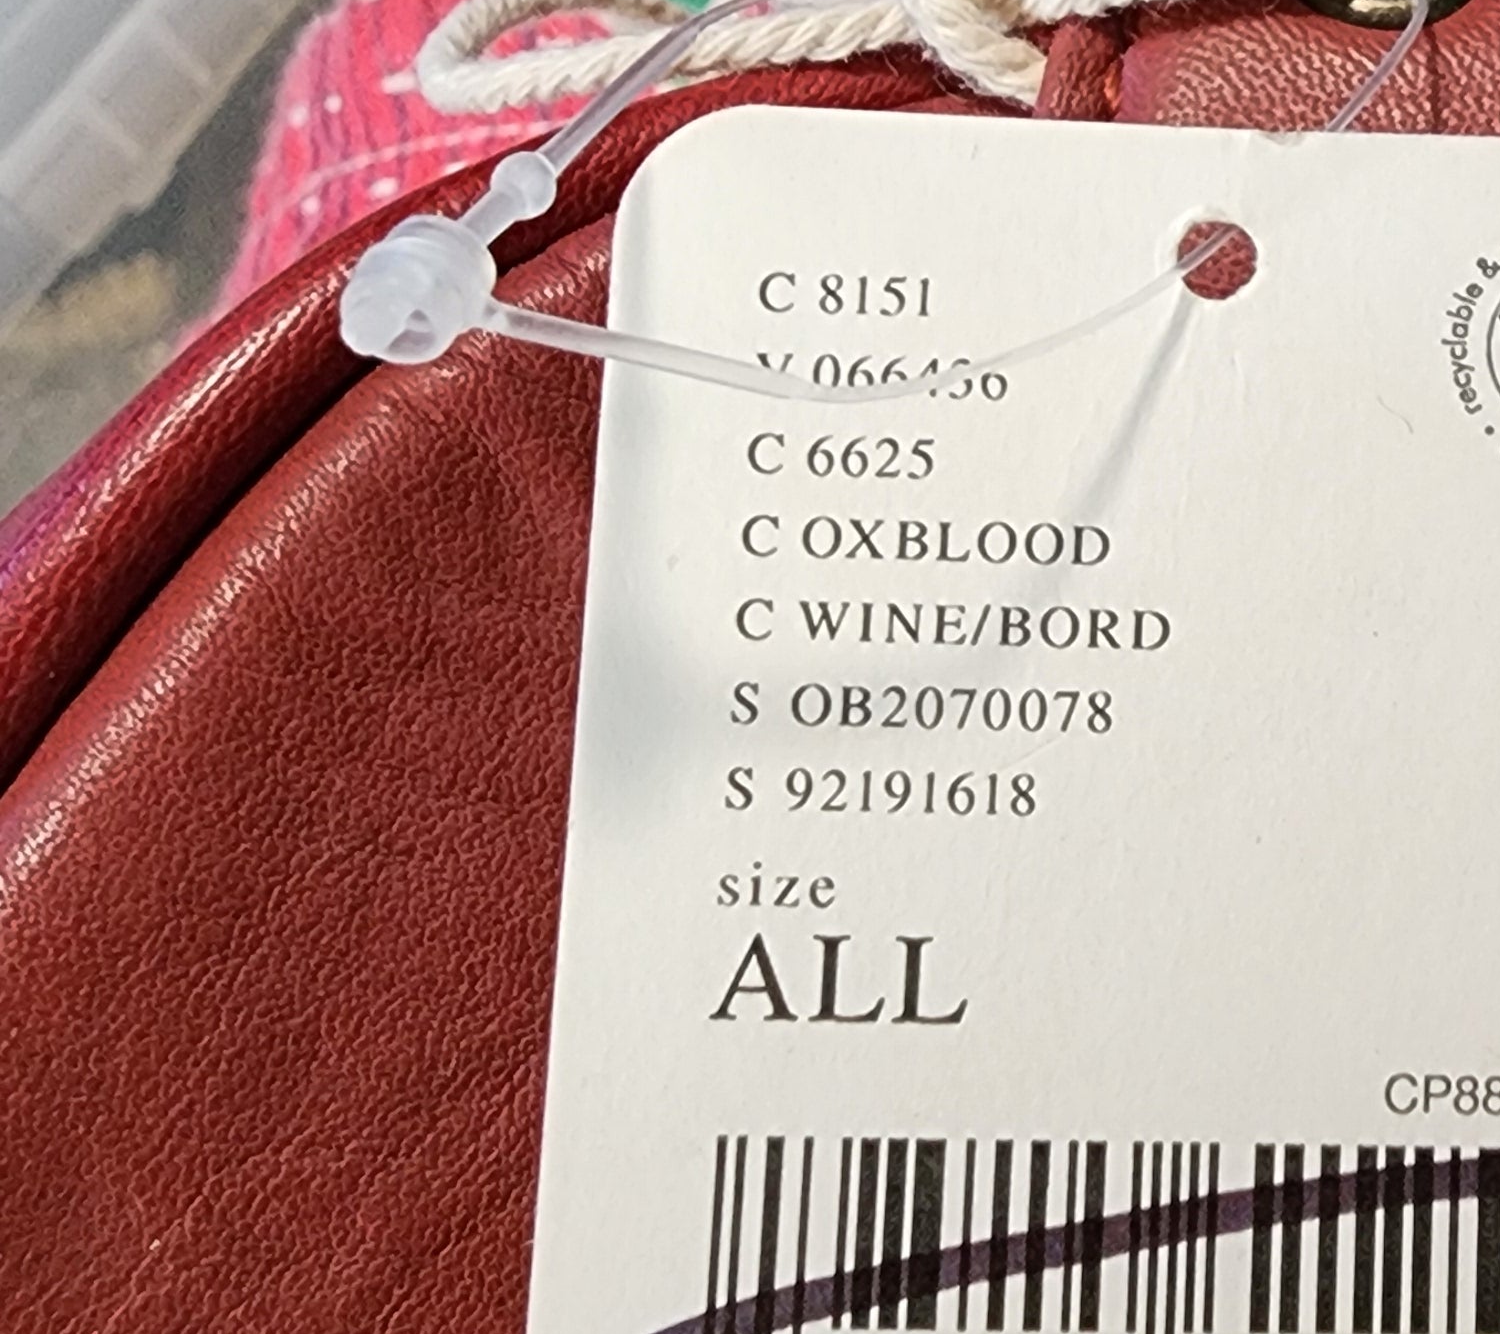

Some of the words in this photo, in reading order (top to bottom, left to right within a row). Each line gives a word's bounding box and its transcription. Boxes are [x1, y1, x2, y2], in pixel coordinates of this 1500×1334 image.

[758, 271, 797, 313] C
[818, 273, 932, 317] 8151
[1440, 281, 1485, 416] recyclable
[746, 432, 785, 475] C
[806, 437, 935, 480] 6625
[741, 514, 780, 558] C
[801, 516, 1111, 566] OXBLOOD
[735, 597, 774, 642] C
[798, 600, 1171, 652] WINE/BORD
[729, 681, 761, 726] S
[790, 682, 1113, 734] OB2070078
[723, 766, 754, 811] S
[785, 767, 1036, 817] 92191618
[716, 860, 836, 910] size
[708, 932, 969, 1026] ALL
